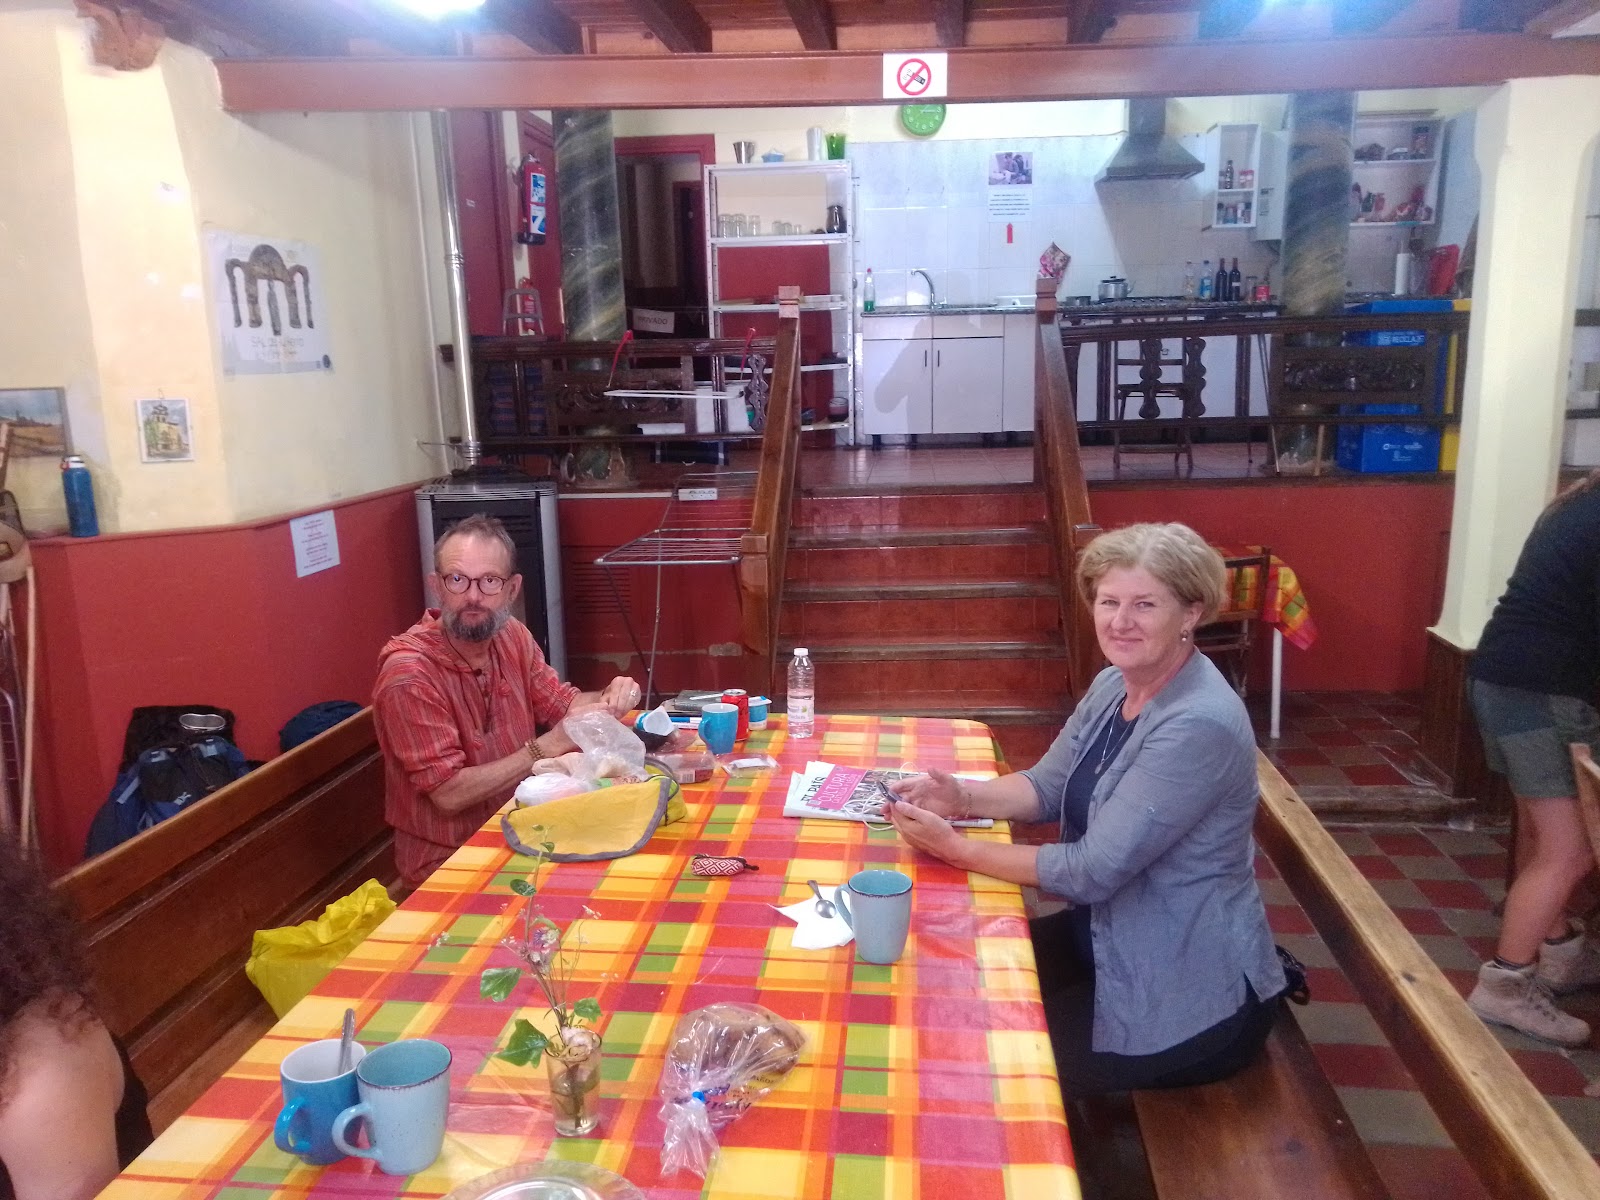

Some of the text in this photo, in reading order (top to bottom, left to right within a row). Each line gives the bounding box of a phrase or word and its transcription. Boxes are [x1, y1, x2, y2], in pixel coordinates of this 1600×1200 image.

[638, 316, 668, 325] PRIVADO
[807, 775, 827, 792] PAÍS
[818, 772, 849, 801] CULTURA
